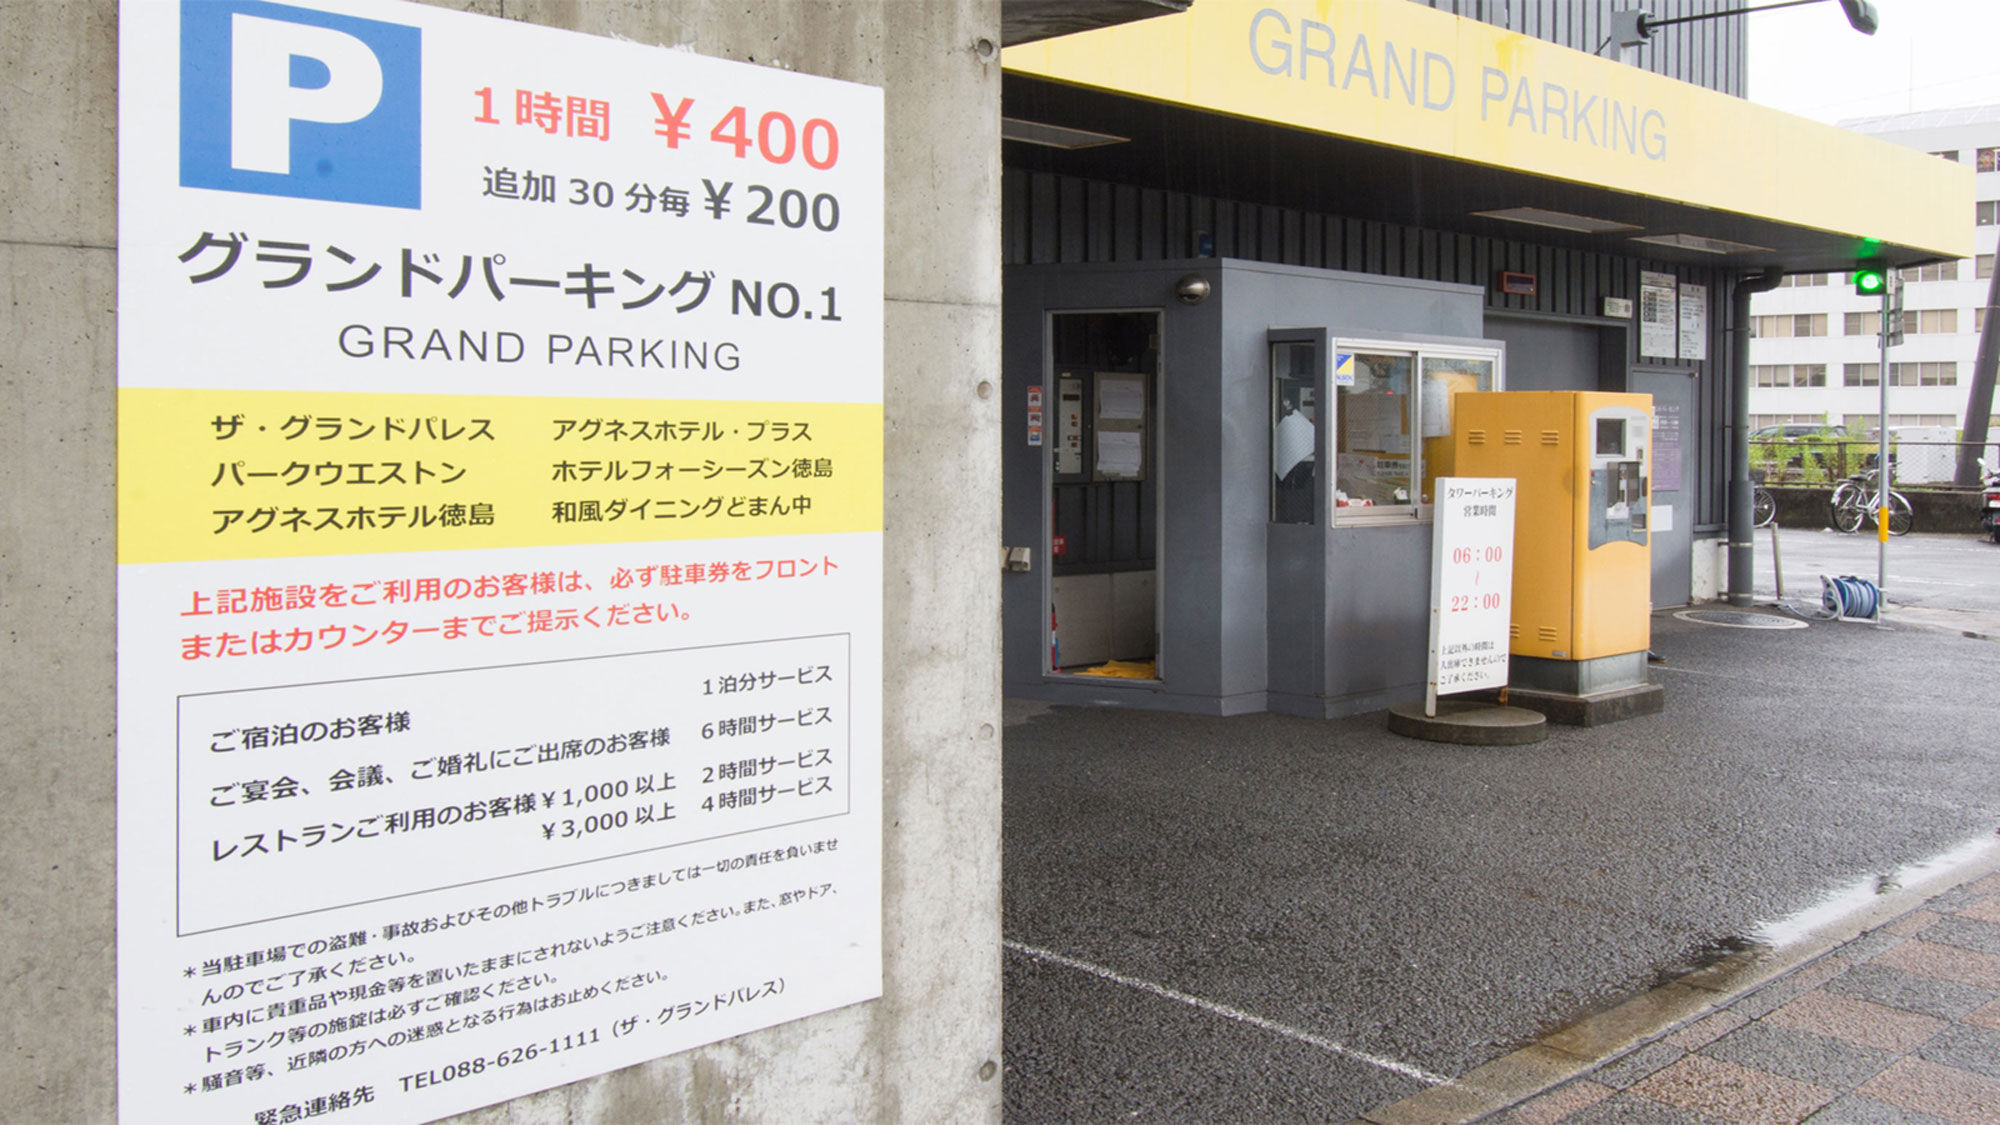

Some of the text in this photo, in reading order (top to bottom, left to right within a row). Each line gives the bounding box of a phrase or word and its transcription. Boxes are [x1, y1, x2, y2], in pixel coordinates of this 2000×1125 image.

[1249, 7, 1667, 162] GRAND PARKING
[178, 231, 842, 322] グランドパーキング NO.1
[339, 324, 741, 371] GRAND PARKING
[211, 413, 496, 441] ザ・グランドパレス
[553, 418, 813, 442] アグネスホテル・プラス
[211, 460, 467, 487] パークウエストン
[552, 457, 834, 482] ホテルフォーシーズン徳島
[213, 502, 496, 535] アグネスホテル徳島
[552, 495, 812, 523] 和風ダイニングどまん中
[1463, 504, 1497, 518] 営業時間
[181, 602, 692, 661] またはカウンターまでご提示ください。
[210, 710, 411, 753] ご宿泊のお客様
[201, 949, 416, 1006] んのでご了承ください。
